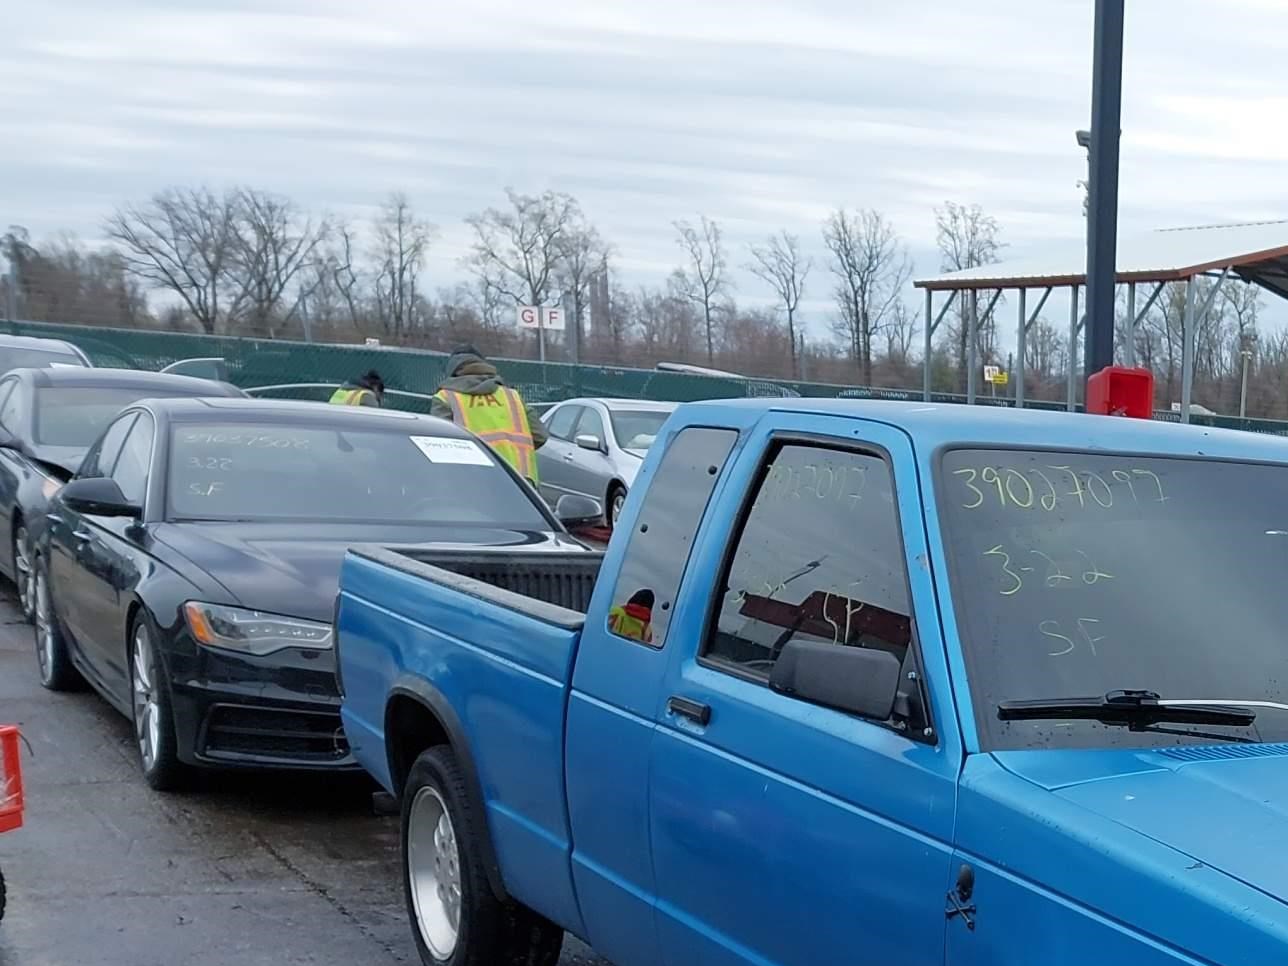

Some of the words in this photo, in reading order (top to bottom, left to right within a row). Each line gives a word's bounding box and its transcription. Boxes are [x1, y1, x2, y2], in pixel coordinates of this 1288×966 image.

[521, 308, 534, 324] G
[548, 311, 558, 325] F
[952, 465, 1169, 511] 39027097
[982, 545, 1116, 595] 3-22
[1038, 617, 1106, 656] SF
